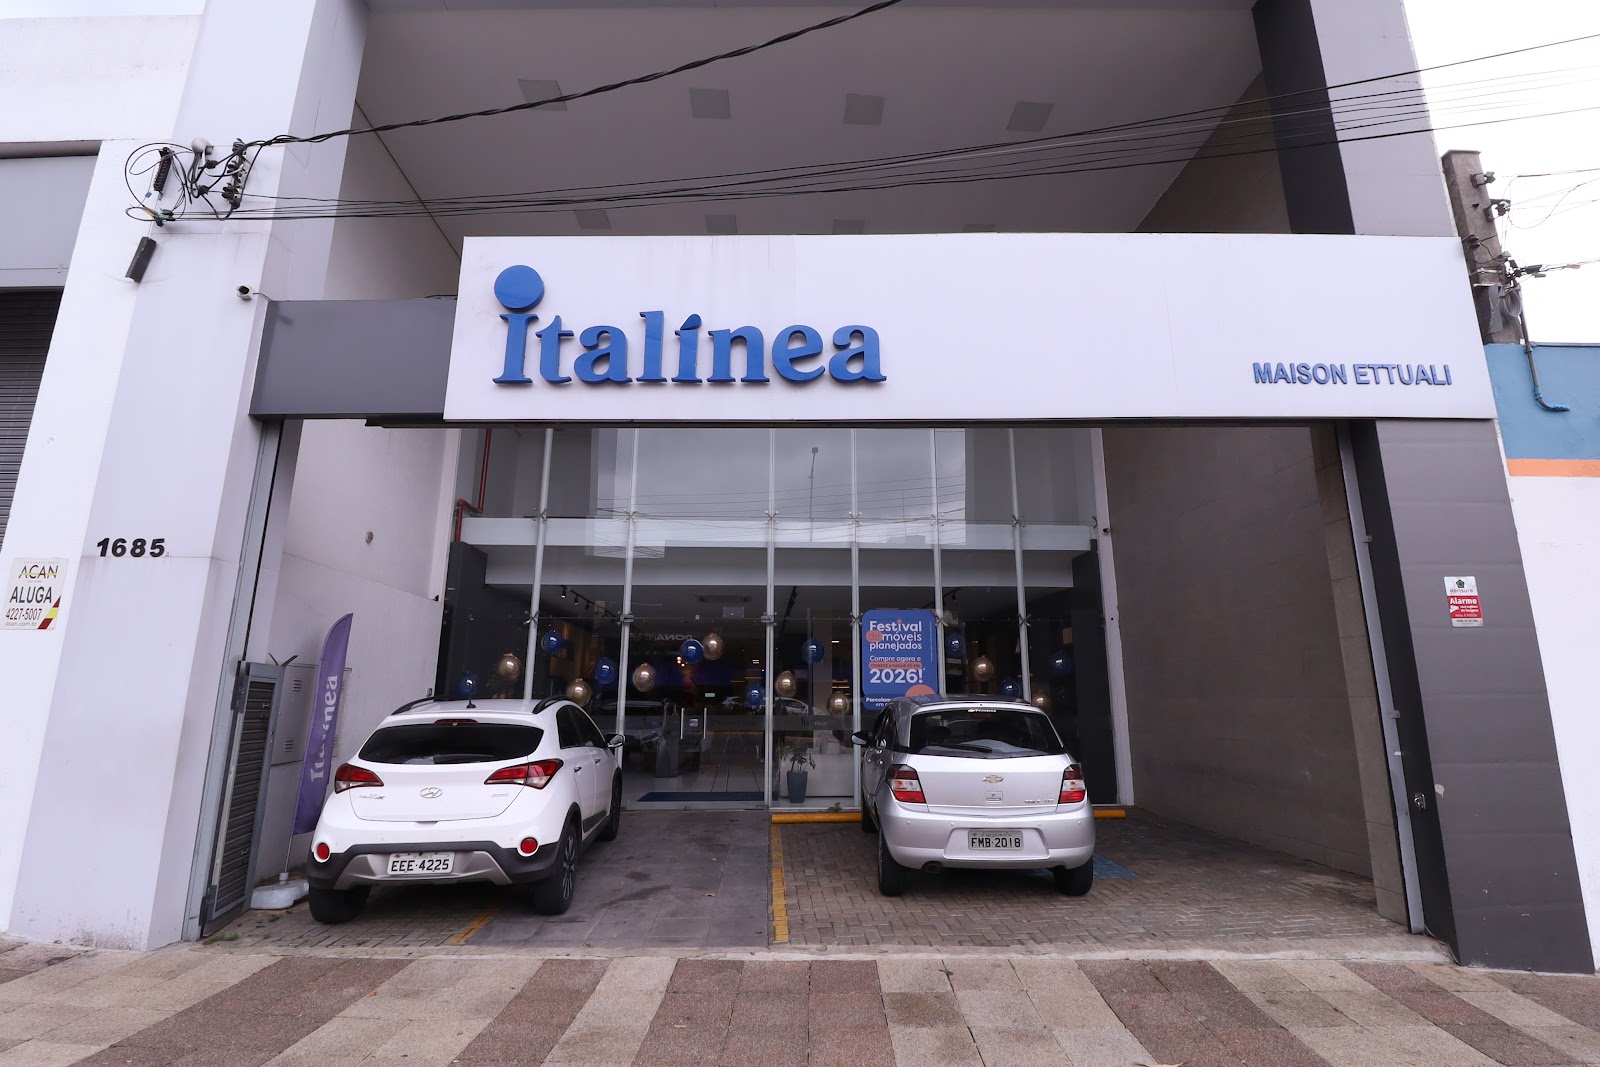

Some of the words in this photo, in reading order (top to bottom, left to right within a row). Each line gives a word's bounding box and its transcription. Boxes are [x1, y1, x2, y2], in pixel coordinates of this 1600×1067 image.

[492, 264, 888, 384] Italínea
[1253, 362, 1348, 385] MAISON
[1353, 363, 1453, 386] ETTUALI
[97, 538, 165, 558] 1685
[18, 564, 59, 579] ACAN
[9, 586, 52, 604] ALUGA
[5, 607, 43, 621] 4227-5007
[869, 619, 922, 632] Festival
[882, 631, 922, 642] móveis
[869, 642, 922, 652] planejados
